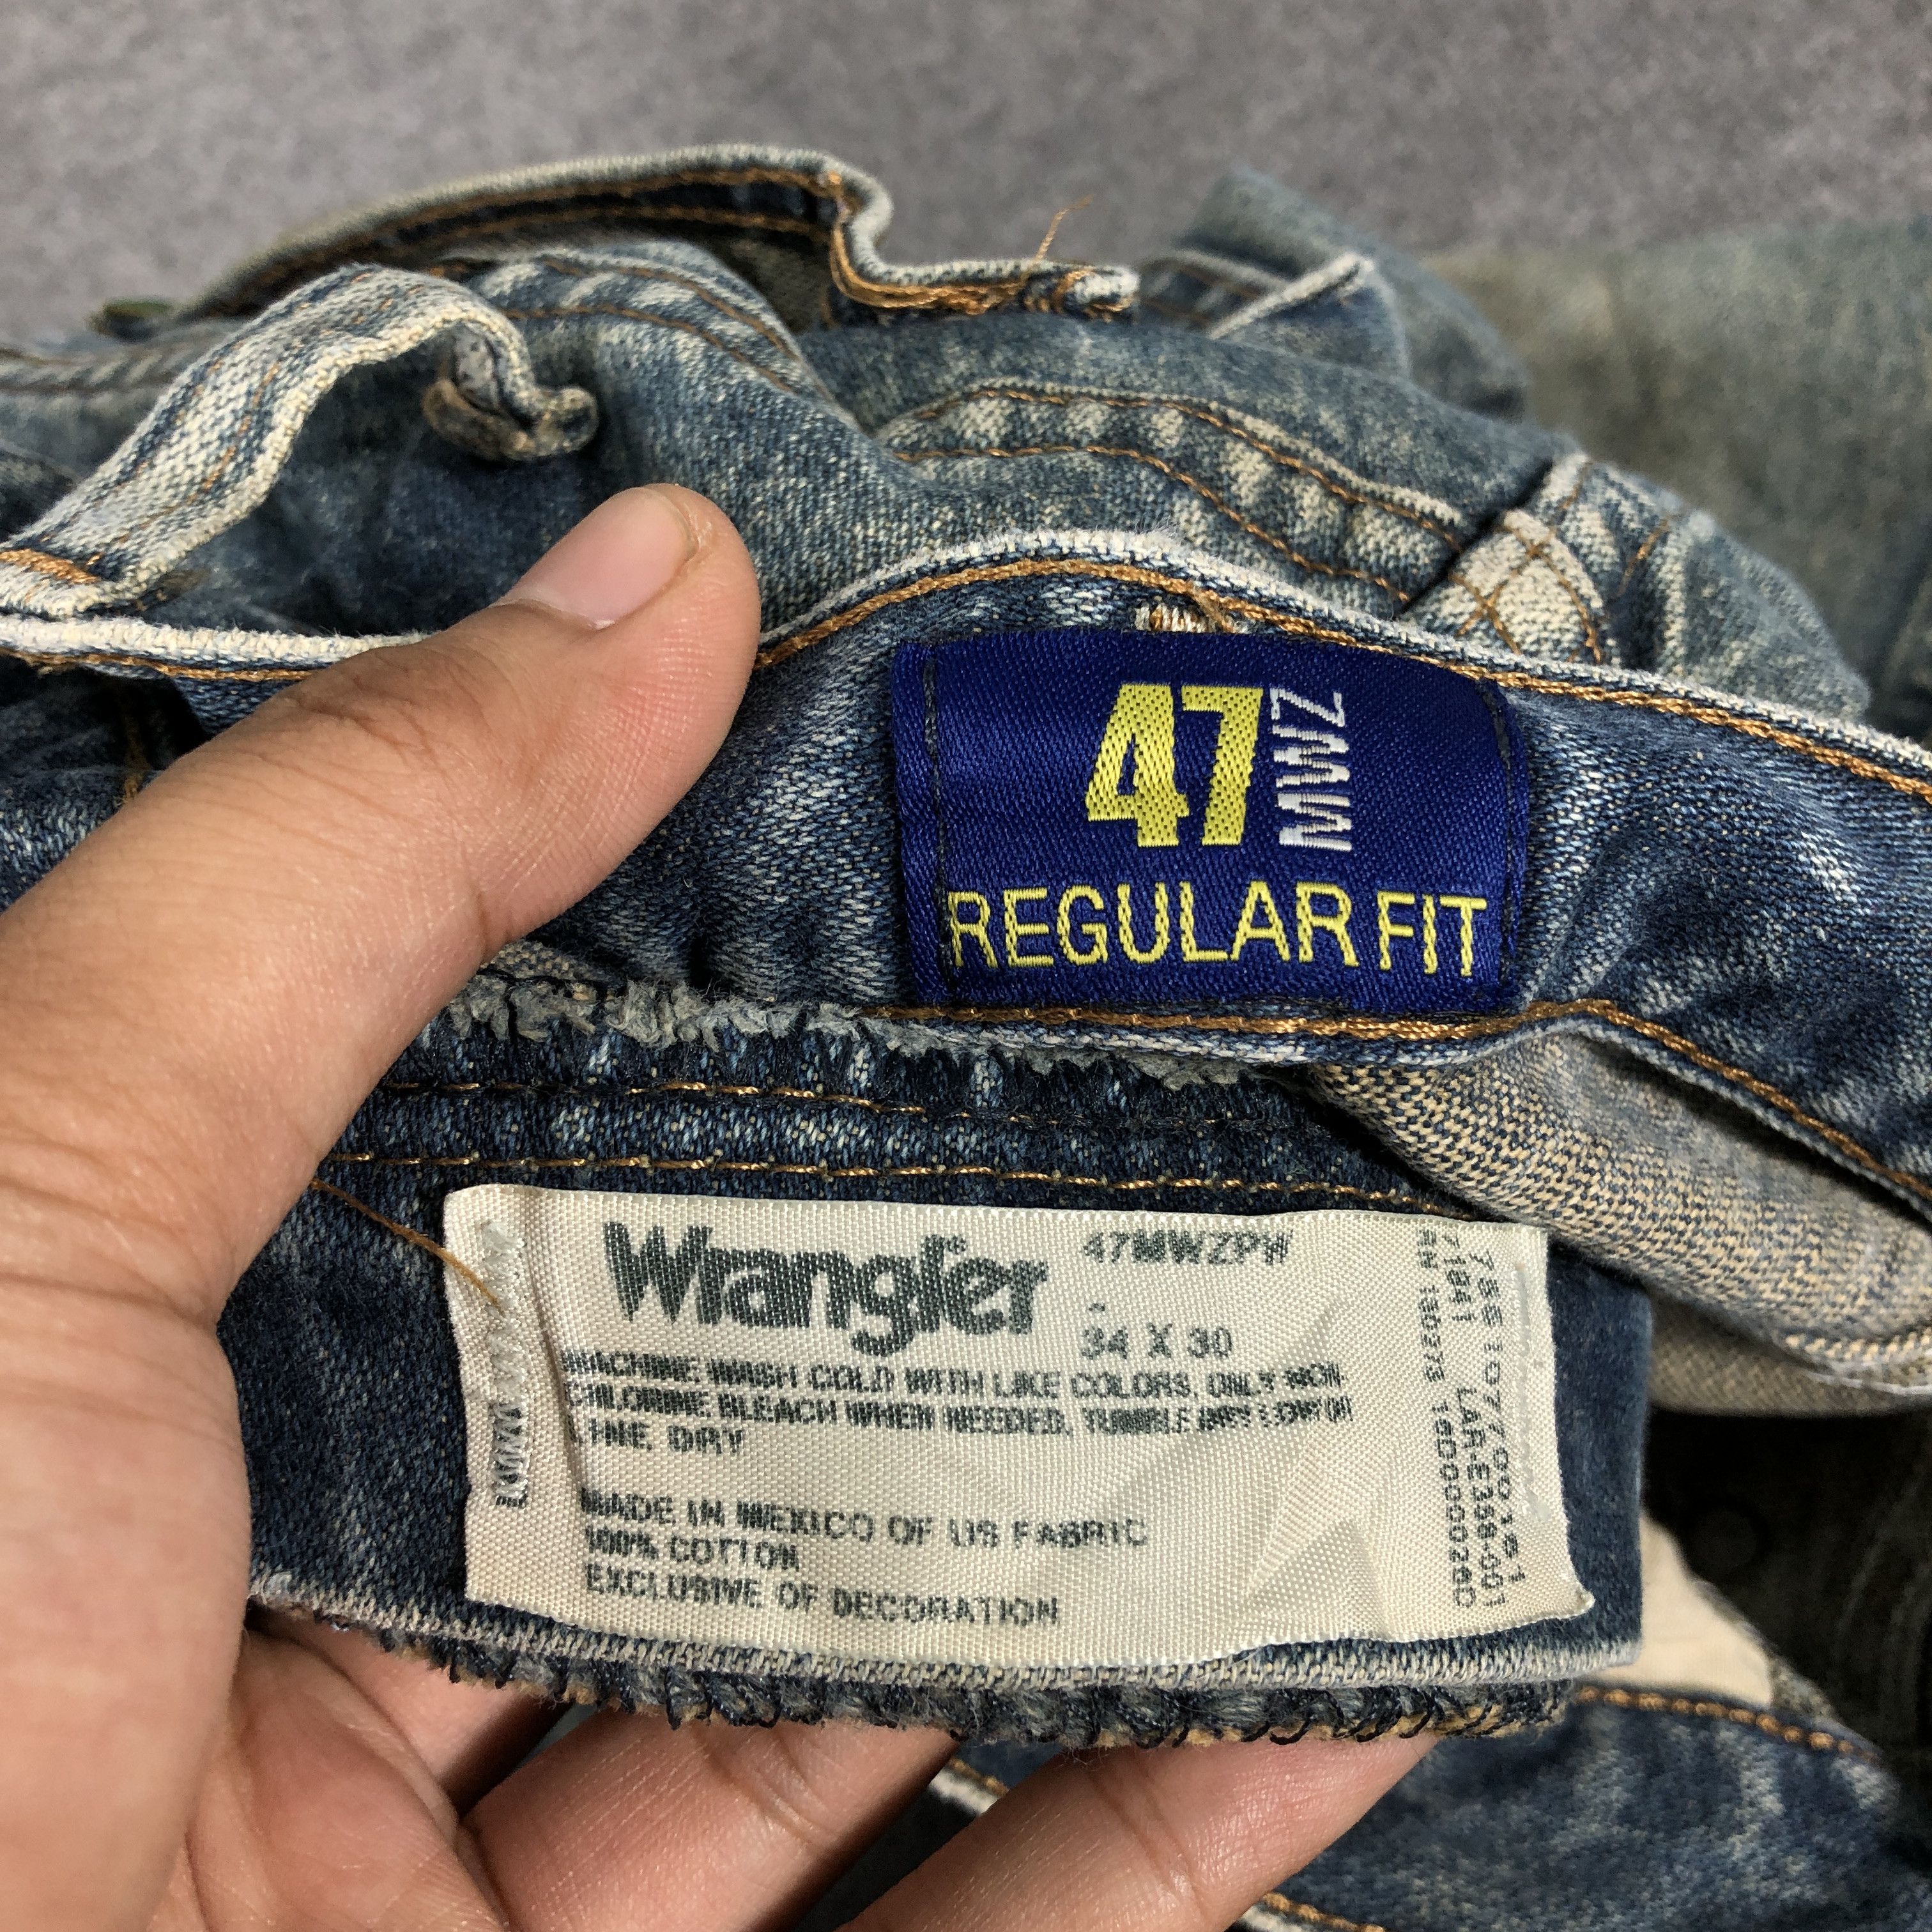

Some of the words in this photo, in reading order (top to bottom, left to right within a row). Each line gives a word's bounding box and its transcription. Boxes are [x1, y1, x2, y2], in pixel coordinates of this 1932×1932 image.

[1085, 682, 1264, 848] 47
[1269, 686, 1353, 852] MWZ
[948, 880, 1359, 968] REGULAR
[1377, 890, 1487, 977] FIT
[1416, 1229, 1438, 1269] RN
[603, 1221, 1048, 1357] Wrangler
[1081, 1325, 1128, 1360] 34
[1186, 1325, 1232, 1359] 30
[707, 1358, 797, 1389] WASH
[809, 1364, 894, 1393] COLD
[905, 1367, 984, 1397] WITH
[993, 1370, 1061, 1399] LIKE
[1207, 1368, 1276, 1397] ONLY
[668, 1425, 743, 1455] DRY
[717, 1392, 836, 1425] BLEACH
[845, 1400, 934, 1432] WHEN
[1083, 1406, 1192, 1436] TUMBLE
[1198, 1404, 1252, 1432] DRY
[579, 1487, 676, 1525] MADE
[687, 1499, 725, 1528] IN
[737, 1500, 875, 1544] MEXICO
[887, 1515, 933, 1547] OF
[948, 1517, 999, 1548] US
[1012, 1517, 1149, 1549] FABRIC
[585, 1525, 659, 1560] 100%
[670, 1535, 801, 1572] COTTON
[585, 1563, 763, 1609] EXCLUSIVE
[777, 1581, 818, 1613] OF
[832, 1586, 1059, 1627] DECORATION
